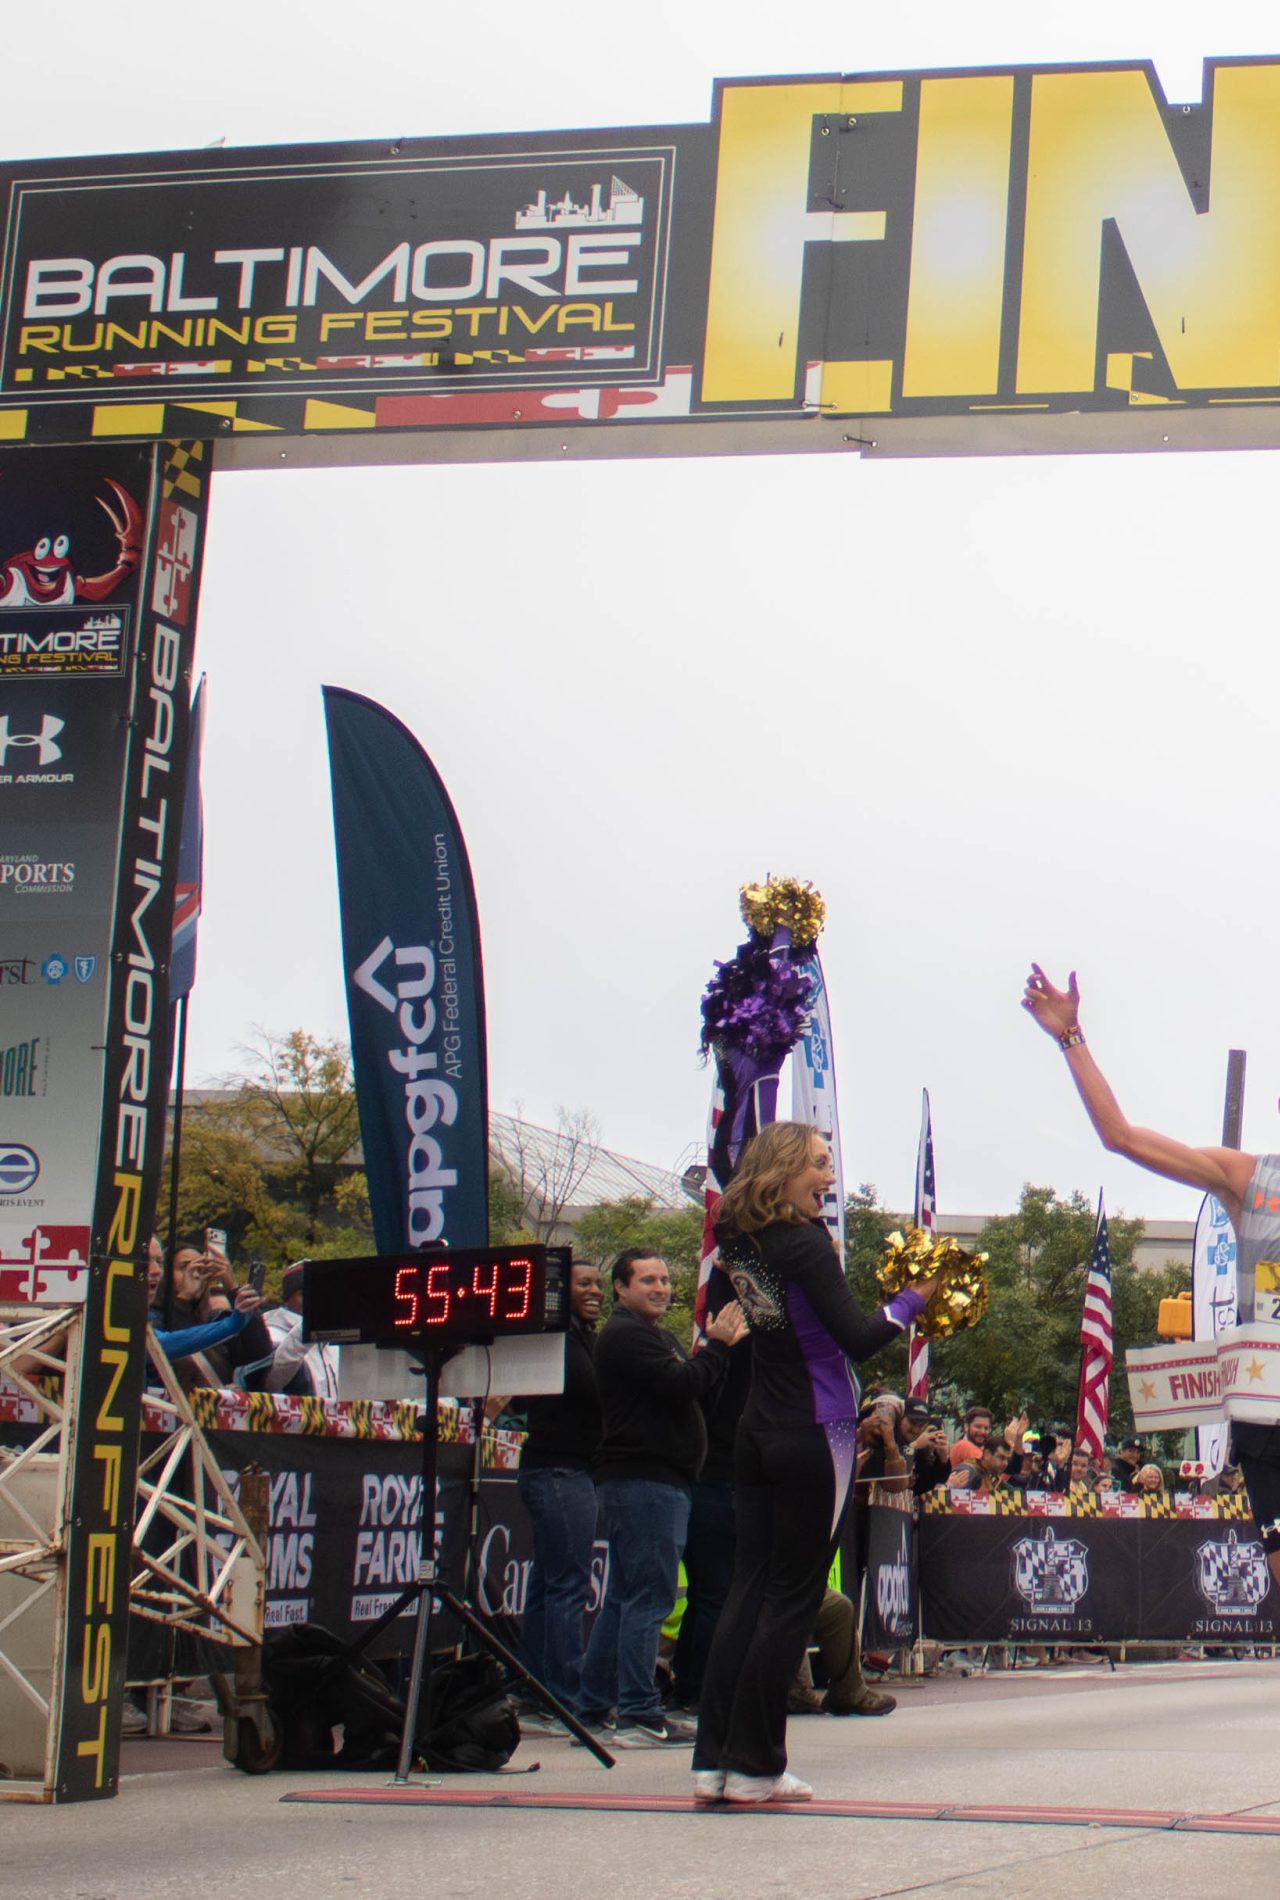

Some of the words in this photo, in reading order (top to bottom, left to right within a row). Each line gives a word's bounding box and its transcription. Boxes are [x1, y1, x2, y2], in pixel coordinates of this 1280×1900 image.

[22, 232, 642, 319] BALTIMORE
[19, 315, 298, 354] RUNNING
[319, 301, 636, 342] FESTIVAL
[27, 651, 118, 664] FESTIVAL
[15, 773, 75, 783] ARMOUR
[433, 832, 451, 889] Union
[115, 622, 181, 1172] BALTIMORE
[437, 894, 455, 956] Credit
[440, 957, 460, 1032] Federal
[443, 1036, 463, 1079] APG
[387, 945, 459, 1248] apgfcu
[16, 1199, 45, 1208] EVENT
[1168, 1370, 1221, 1401] FINISH
[76, 1172, 143, 1789] RUNFEST
[265, 1606, 284, 1623] Real
[355, 1599, 372, 1617] Real
[1010, 1618, 1072, 1632] SIGNAL
[1077, 1618, 1093, 1632] 13
[1195, 1620, 1256, 1633] SIGNAL
[1258, 1620, 1274, 1633] 13
